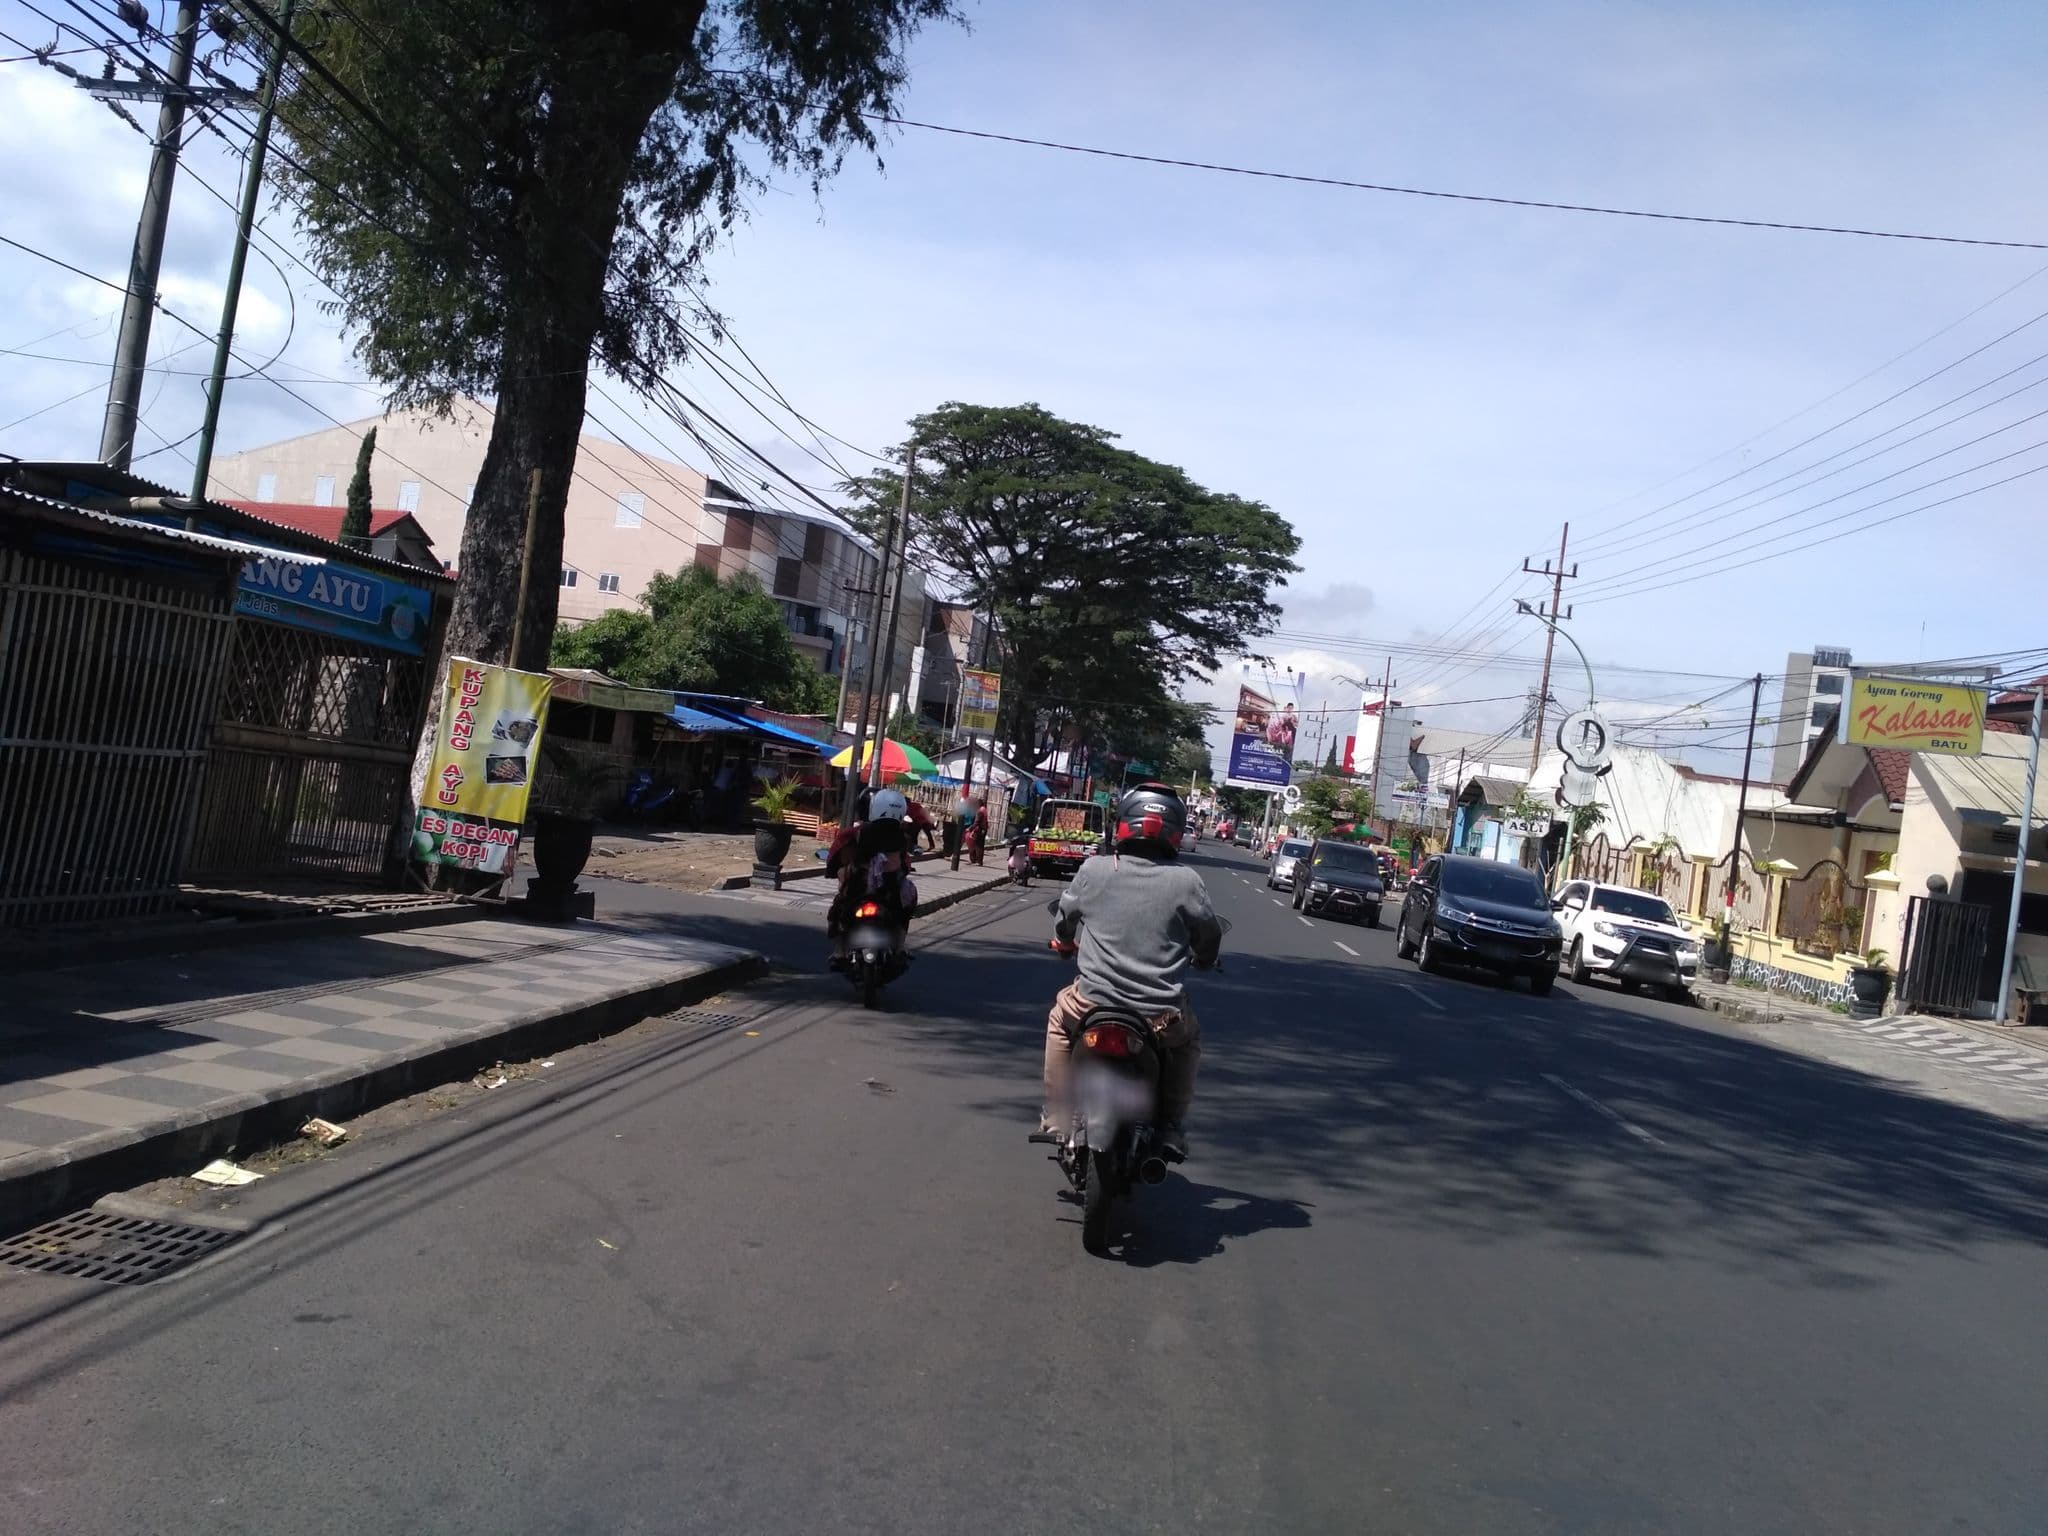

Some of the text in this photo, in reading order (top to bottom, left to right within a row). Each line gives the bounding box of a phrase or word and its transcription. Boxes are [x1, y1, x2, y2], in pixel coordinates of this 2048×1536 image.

[308, 571, 371, 612] AYU
[1863, 683, 1944, 704] Ayam Goreng
[1858, 700, 1974, 740] Kalasan
[438, 668, 486, 805] KUPANG AYU
[1931, 739, 1968, 750] BATU
[421, 816, 517, 846] ES DEGAN
[1508, 821, 1544, 833] ASLI
[440, 840, 489, 862] KOPI
